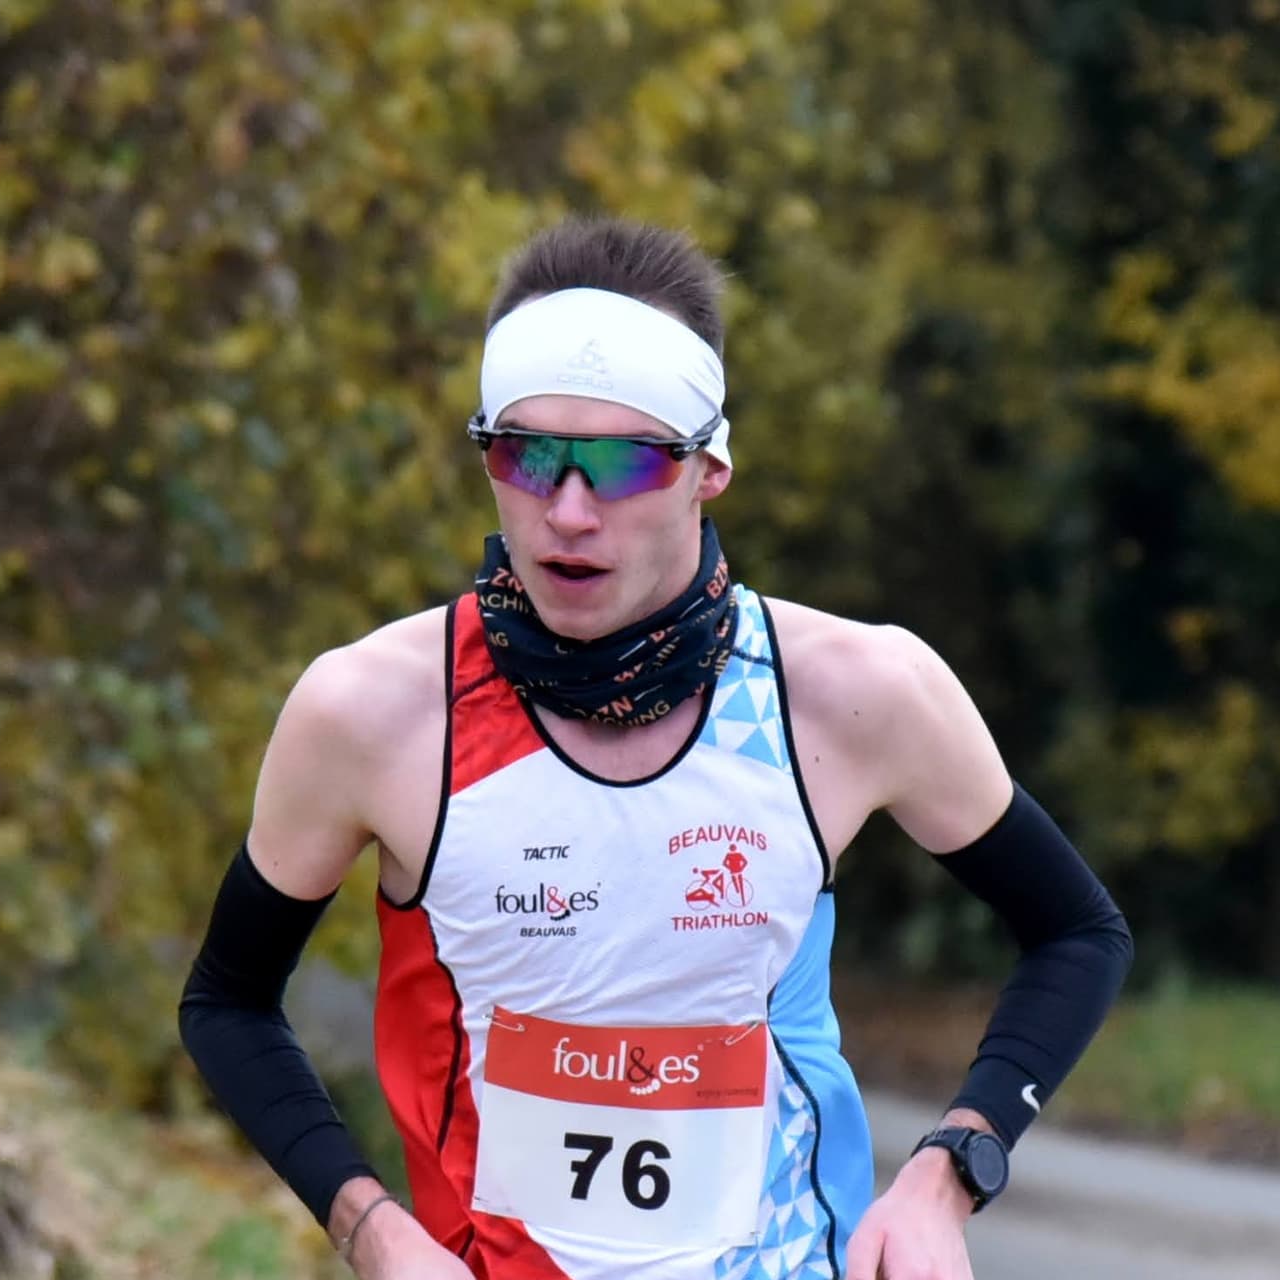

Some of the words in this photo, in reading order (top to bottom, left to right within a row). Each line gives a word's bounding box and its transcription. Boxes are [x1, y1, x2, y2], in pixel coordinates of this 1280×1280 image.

[523, 845, 570, 861] TACTIC
[669, 824, 767, 855] BEAUVAIS
[495, 882, 599, 919] foul&es
[520, 926, 577, 938] BEAUVAIS
[672, 911, 768, 931] TRIATHLON
[553, 1037, 700, 1088] foul&es
[564, 1132, 672, 1211] 76
